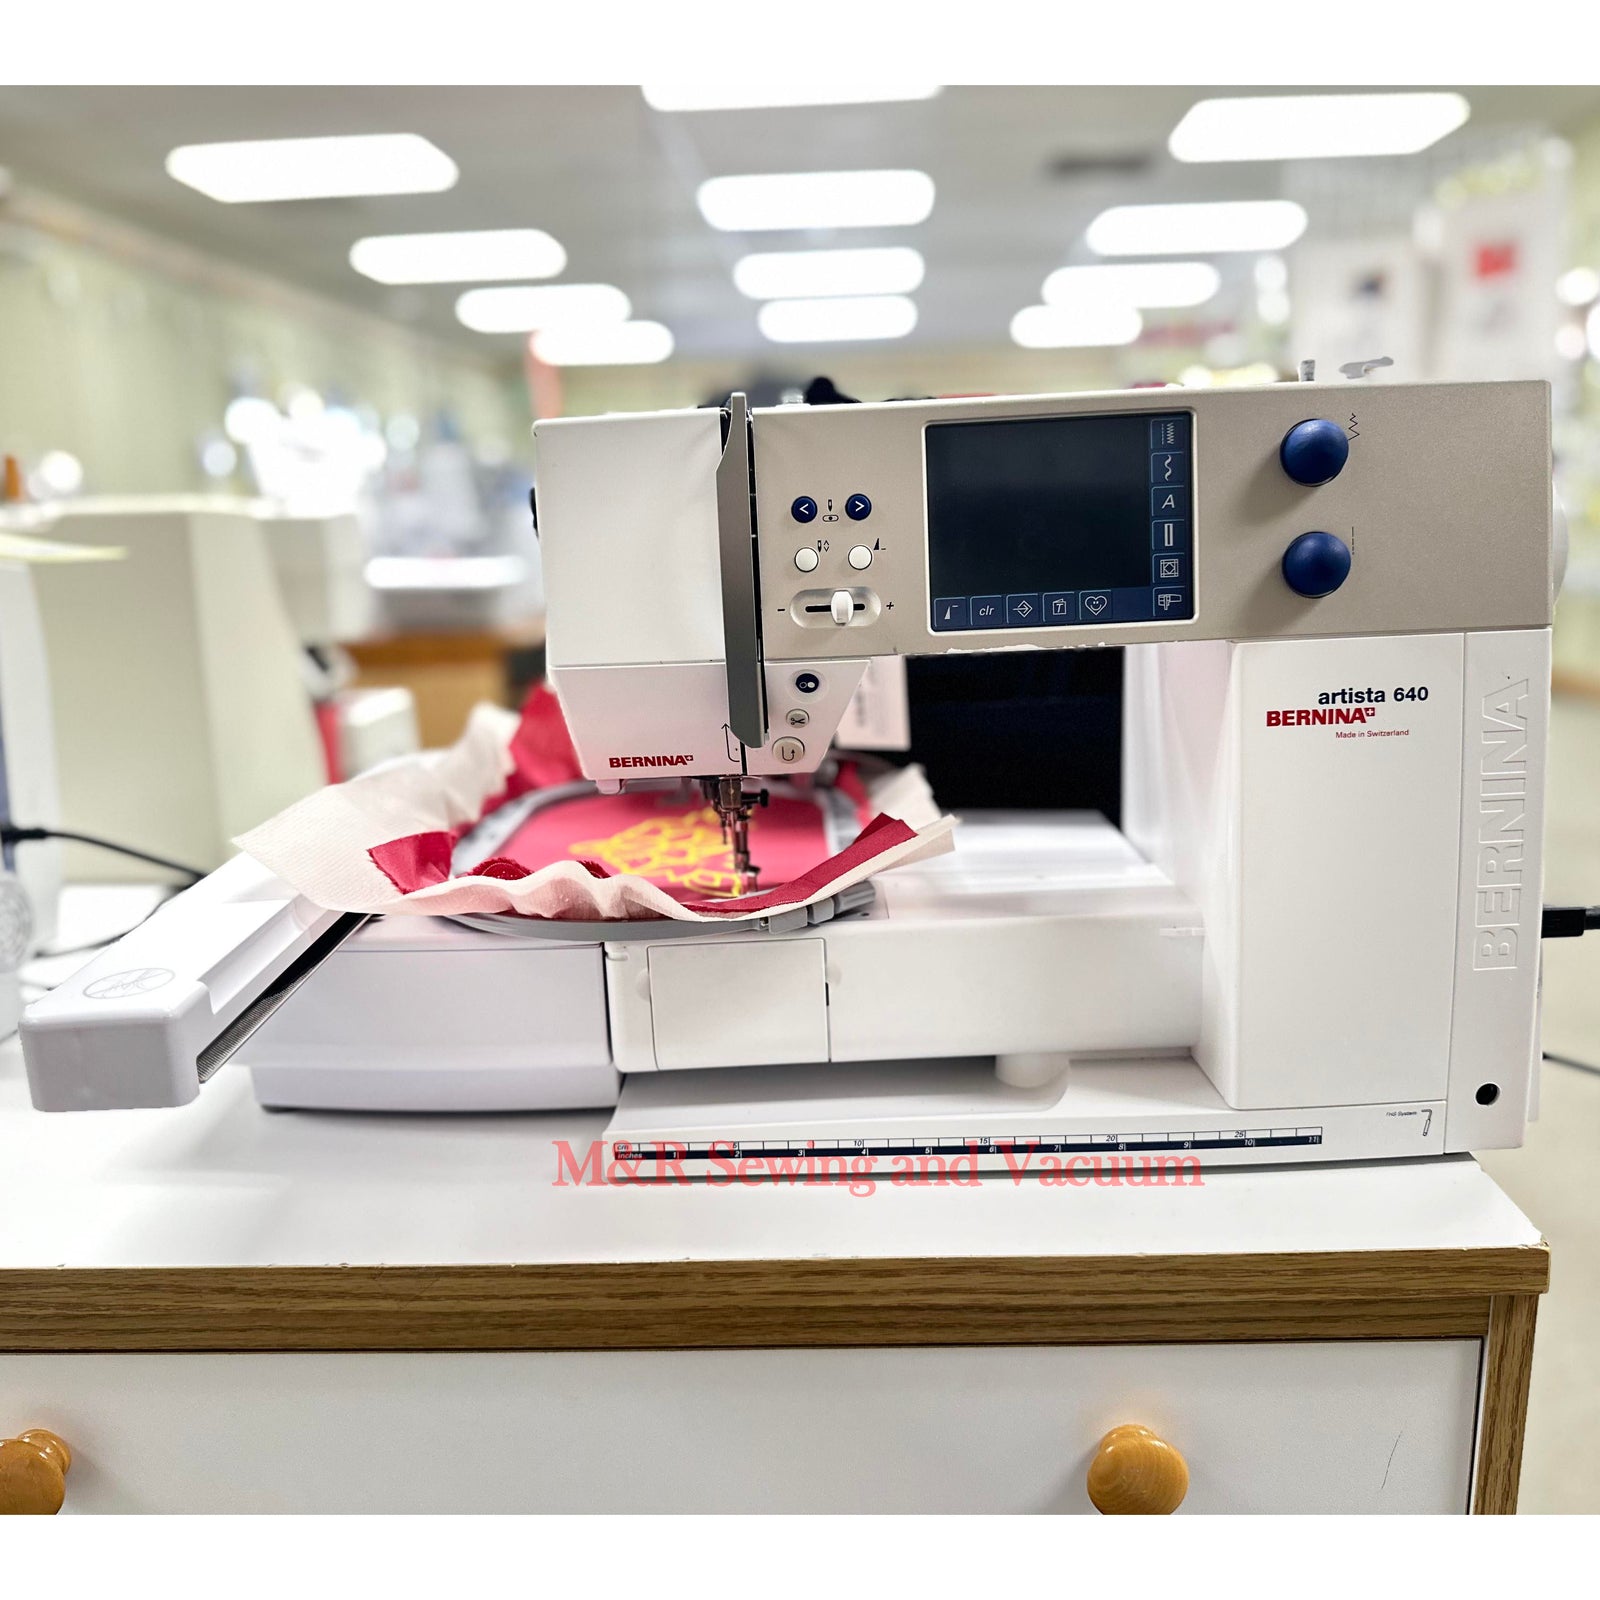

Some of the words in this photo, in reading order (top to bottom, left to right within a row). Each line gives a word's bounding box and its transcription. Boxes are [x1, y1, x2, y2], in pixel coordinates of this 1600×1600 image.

[1161, 494, 1175, 509] A
[979, 605, 995, 617] clr
[1318, 687, 1386, 705] artista
[1393, 686, 1429, 702] 640
[1266, 708, 1367, 727] BERNINA
[1335, 730, 1356, 739] Made
[1358, 730, 1365, 738] in
[1366, 729, 1410, 738] Switzerland
[609, 754, 687, 768] BERNINA
[1473, 677, 1529, 971] BERNINA
[979, 1137, 988, 1145] 15
[617, 1151, 643, 1160] inches
[734, 1150, 740, 1158] 2
[797, 1149, 803, 1157] 3
[988, 1145, 995, 1153] 6
[1118, 1143, 1124, 1151] 8
[1183, 1141, 1189, 1149] 9
[1244, 1138, 1253, 1146] 10
